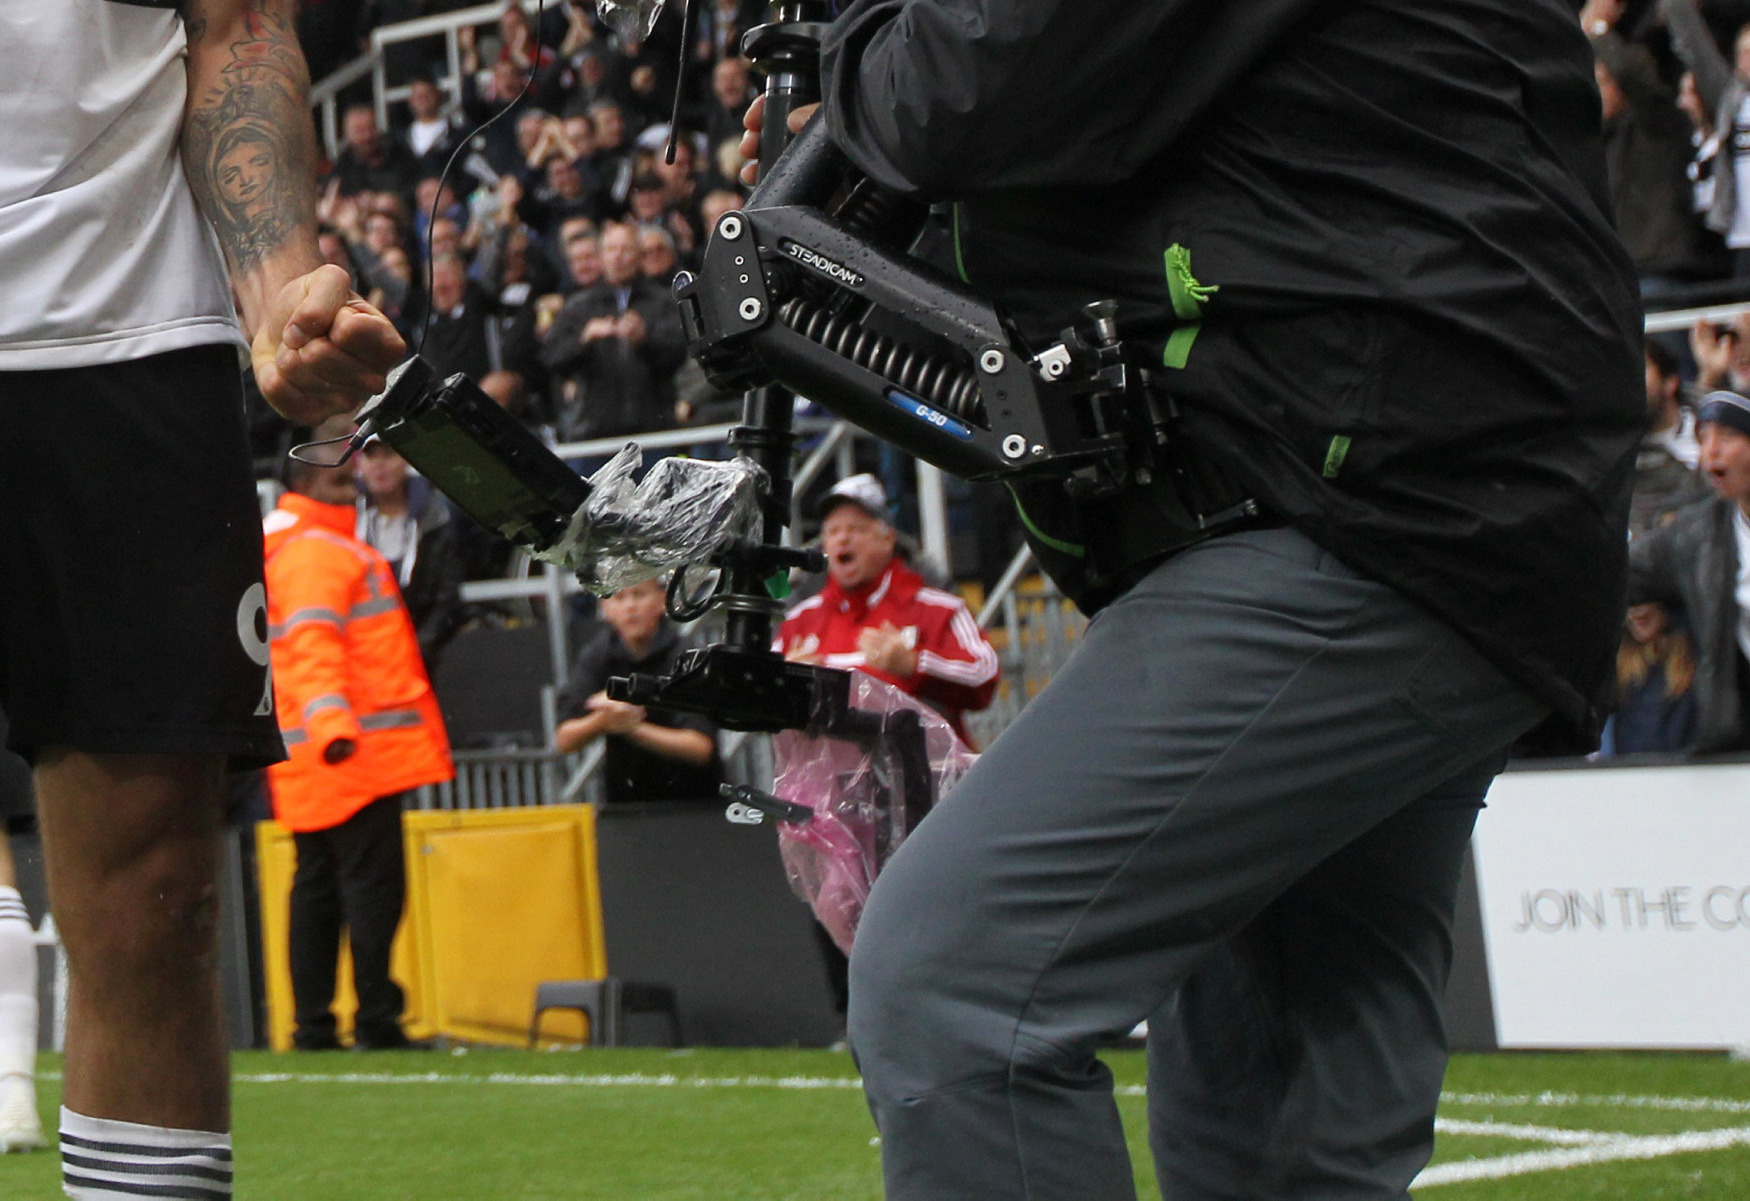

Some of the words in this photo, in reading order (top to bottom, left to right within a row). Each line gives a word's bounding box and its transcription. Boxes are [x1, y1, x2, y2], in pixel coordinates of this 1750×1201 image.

[789, 244, 857, 285] STEADICAM
[915, 404, 948, 427] G-50
[1512, 887, 1607, 933] JOIN
[1613, 885, 1696, 932] THE
